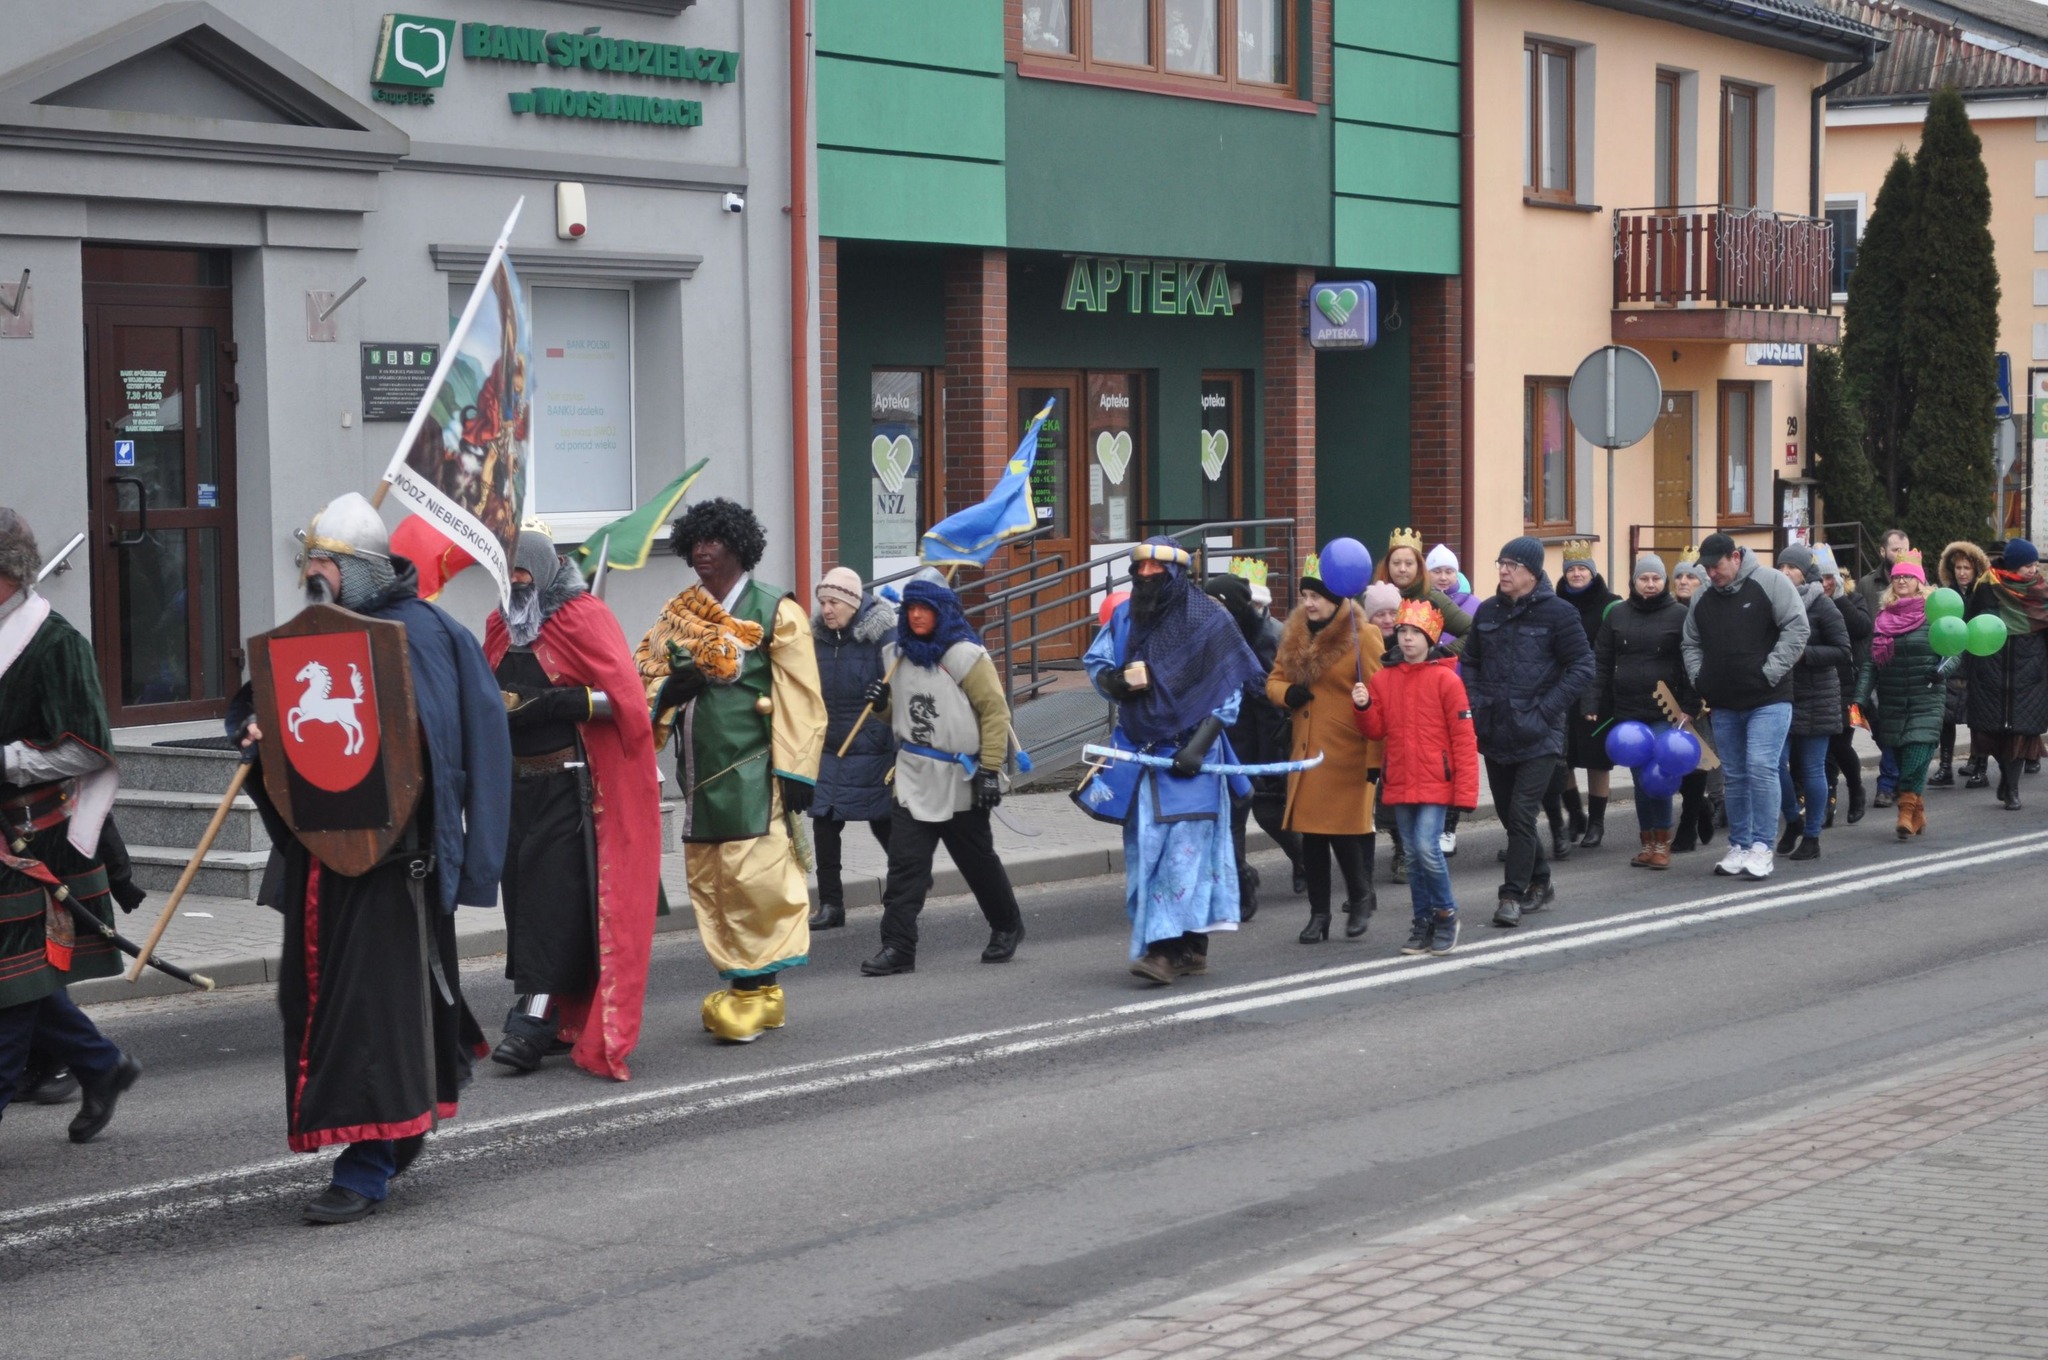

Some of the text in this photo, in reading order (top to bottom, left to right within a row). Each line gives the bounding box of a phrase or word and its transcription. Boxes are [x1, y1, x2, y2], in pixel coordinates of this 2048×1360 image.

[465, 23, 740, 83] BANK SPÓŁDZIELCZY
[538, 87, 702, 127] WOJSŁAWICACH
[1065, 256, 1234, 315] APTEKA
[1318, 328, 1358, 340] APTEKA
[566, 340, 610, 350] BANK POLSKI
[547, 405, 604, 416] BANKU daleko
[874, 393, 910, 413] Apteka
[1100, 393, 1129, 412] Apteka
[1025, 419, 1060, 431] AEKA
[1787, 416, 1797, 436] 29
[555, 440, 617, 452] od ponad wieku
[877, 494, 906, 515] NFZ
[394, 474, 426, 504] WÓDZ
[425, 498, 492, 556] NIEBIESKICH
